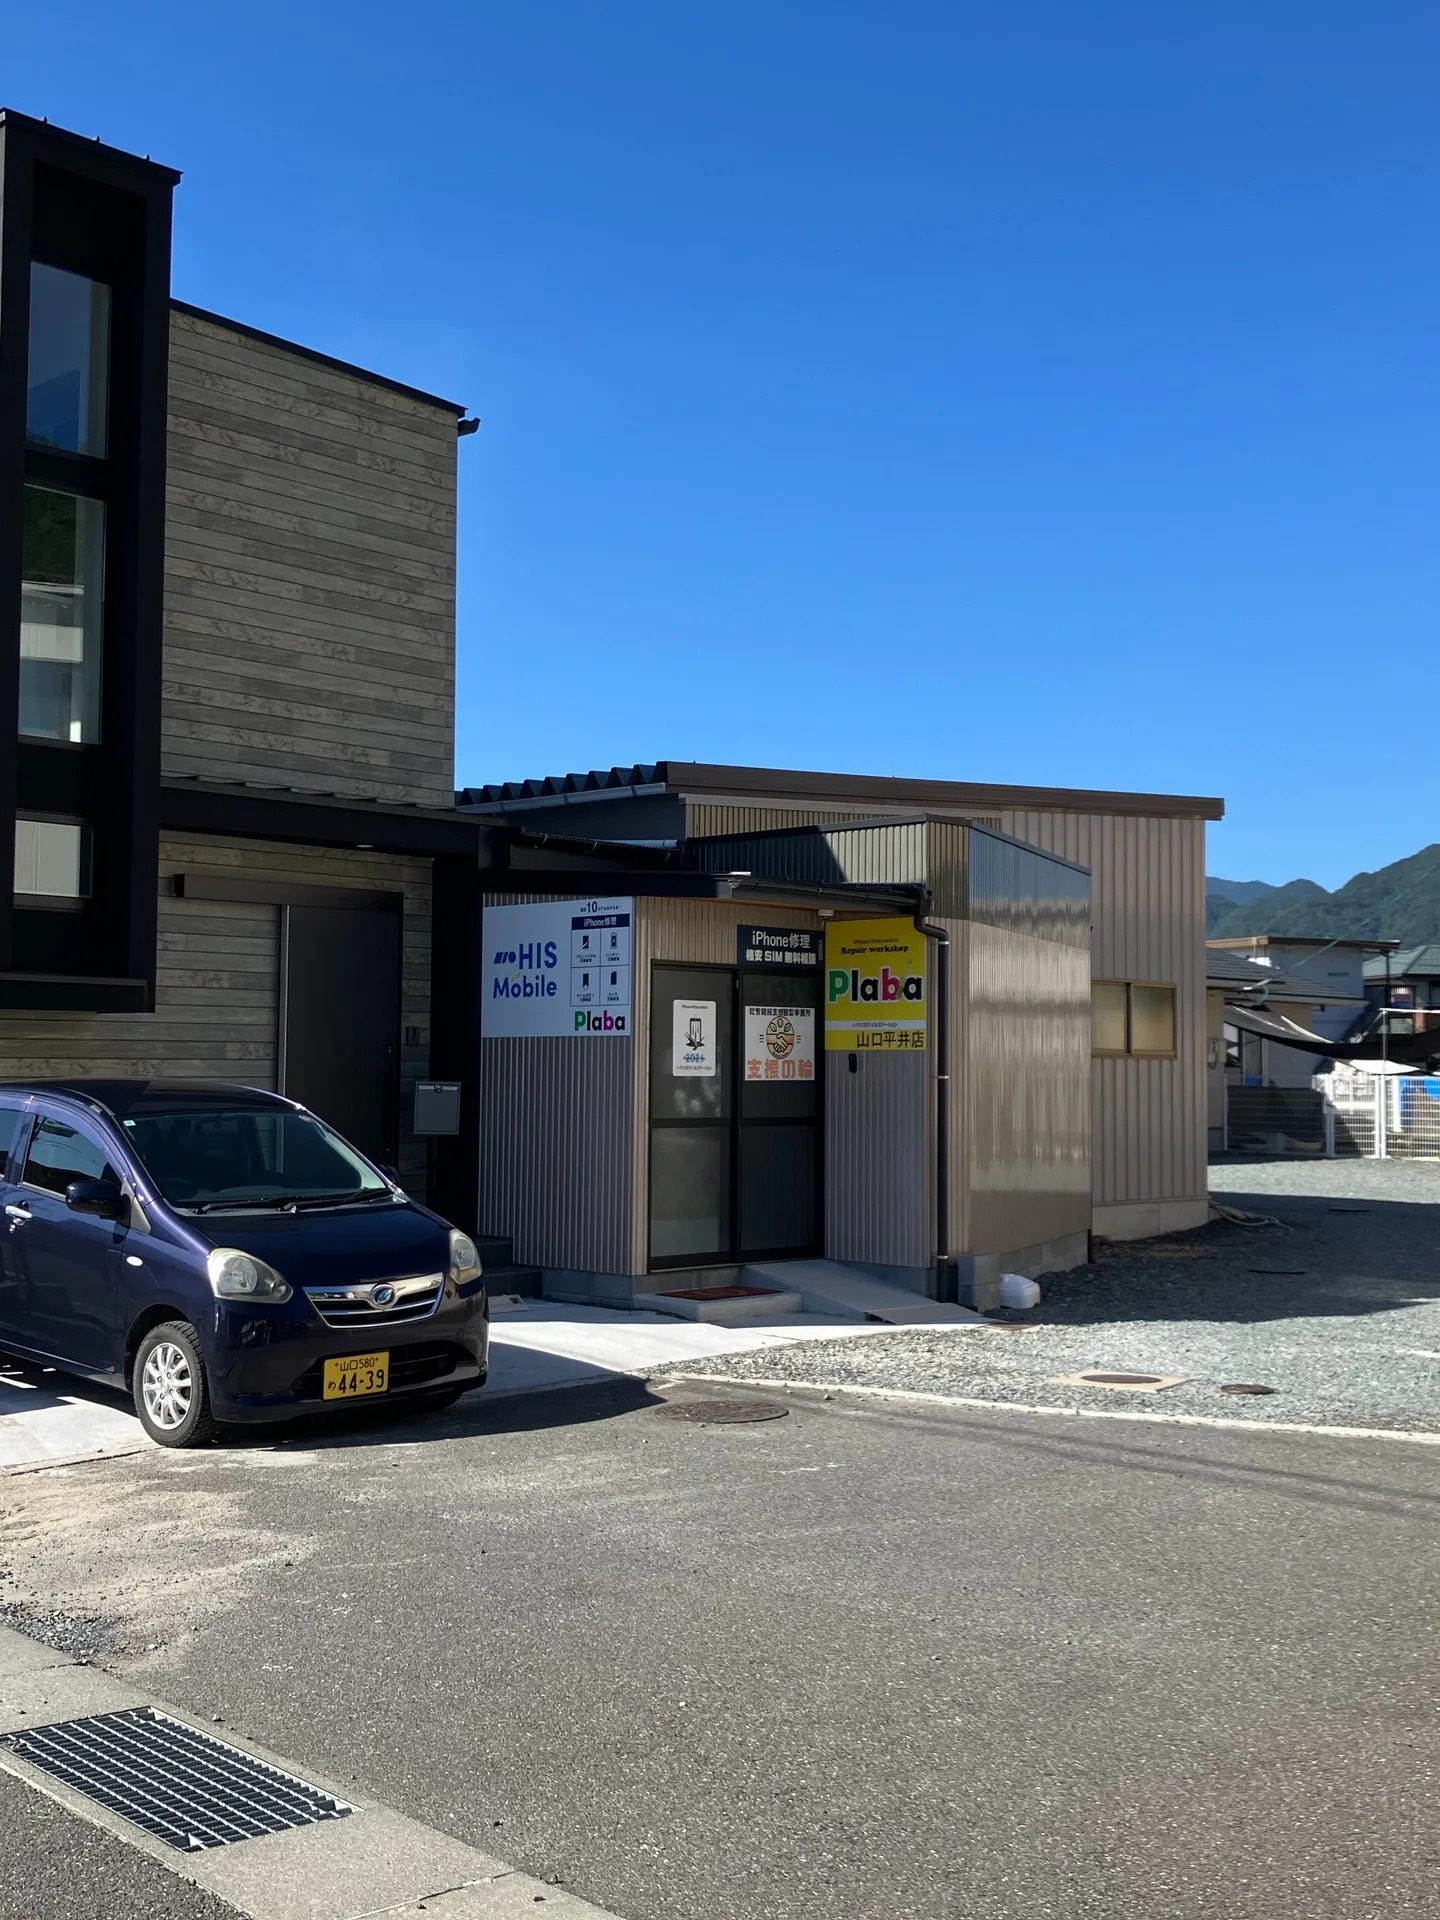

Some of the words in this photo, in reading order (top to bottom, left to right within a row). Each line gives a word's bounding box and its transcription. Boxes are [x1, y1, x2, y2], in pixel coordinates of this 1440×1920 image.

[752, 930, 811, 949] iPhone修理
[841, 946, 867, 955] Repair
[868, 944, 909, 953] workshop
[518, 941, 558, 970] HIS
[764, 950, 783, 963] SIM
[492, 974, 558, 999] Mobile
[828, 967, 923, 1002] Plaba
[574, 1009, 626, 1031] Plaba
[856, 1030, 925, 1048] 山口平井店
[747, 1058, 814, 1079] 支援の輪
[338, 1368, 385, 1394] 44-39
